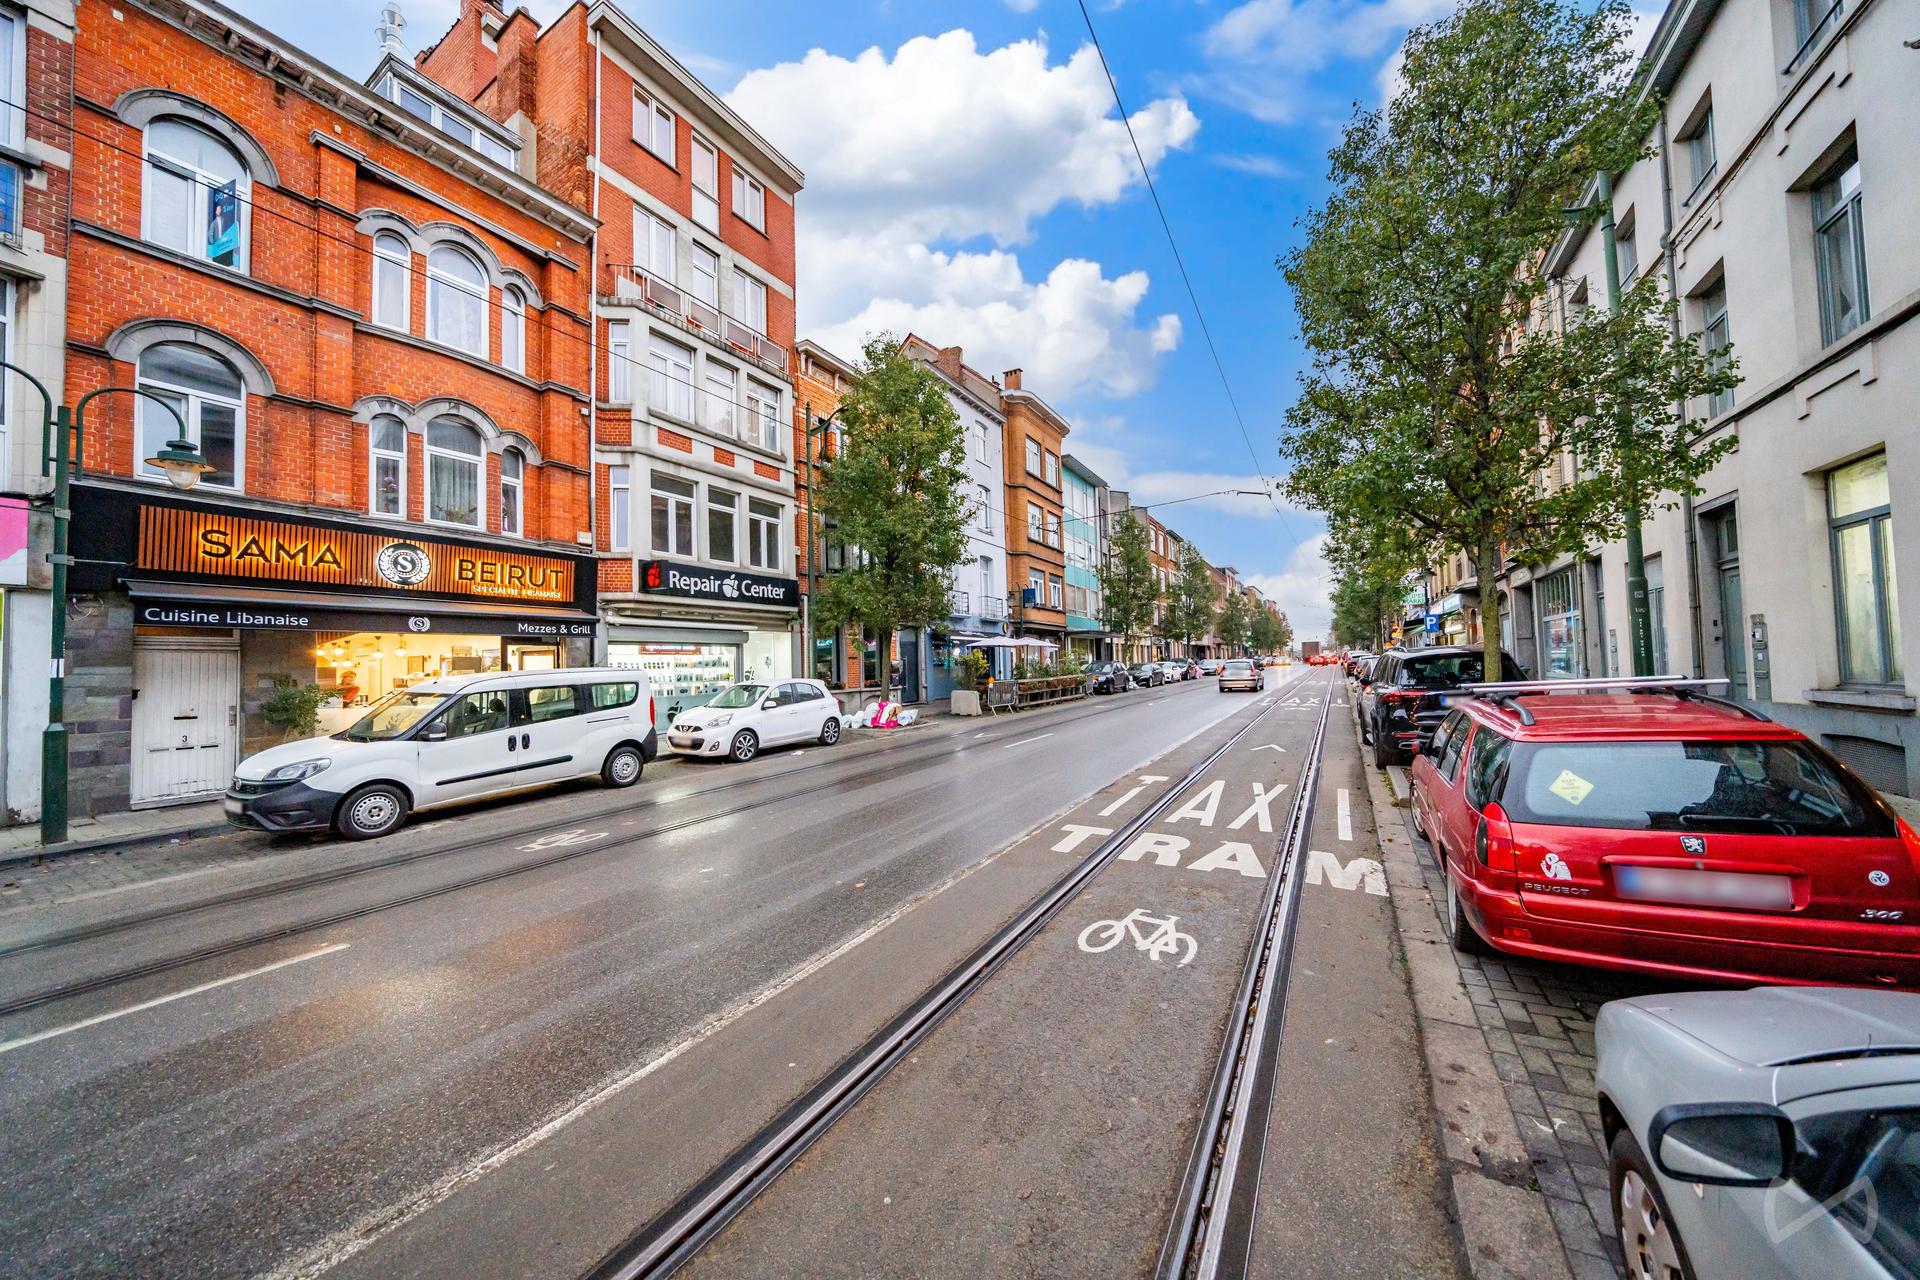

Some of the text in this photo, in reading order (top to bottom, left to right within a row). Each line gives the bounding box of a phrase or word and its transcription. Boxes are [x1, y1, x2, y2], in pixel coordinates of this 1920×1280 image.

[200, 529, 344, 570] SAMA
[456, 558, 564, 590] BEIRUT
[669, 570, 785, 599] Repair Center
[145, 608, 308, 626] Cuisine Libanaise
[518, 623, 591, 634] Mezzes & Grill
[1426, 617, 1437, 630] P
[1097, 775, 1353, 841] TAXI
[1050, 824, 1391, 897] TRAM
[1524, 882, 1590, 896] PEUGEOT
